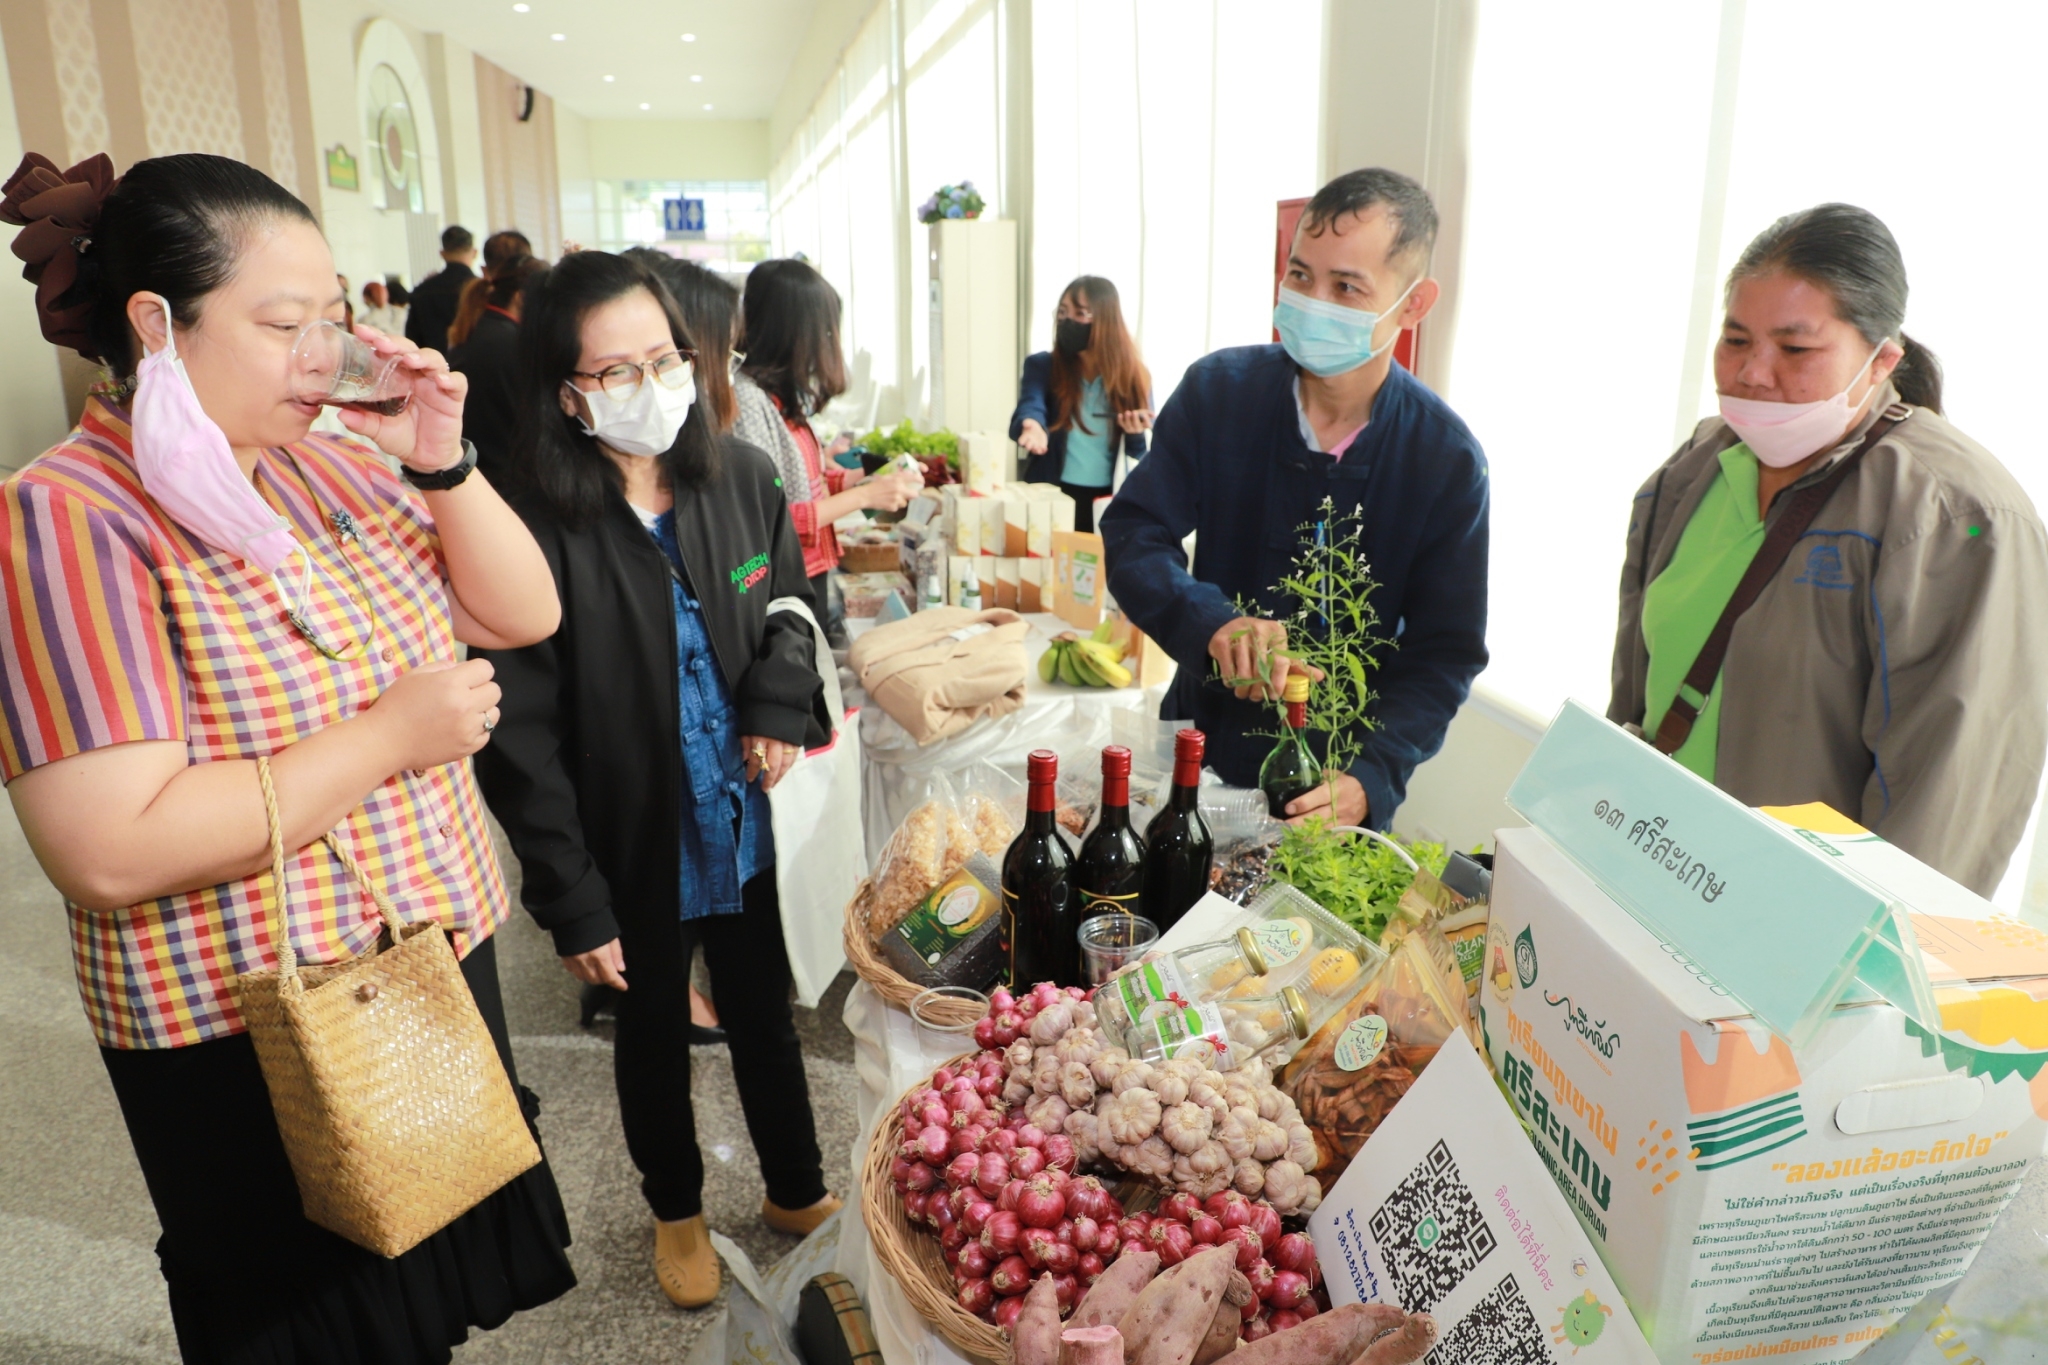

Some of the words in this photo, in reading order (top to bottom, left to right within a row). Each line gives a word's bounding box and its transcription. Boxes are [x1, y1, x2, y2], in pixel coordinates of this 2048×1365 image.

[731, 552, 768, 584] AGTECH
[744, 566, 767, 588] OTOP
[1594, 799, 1625, 831] ๑๓
[1626, 816, 1727, 903] ศรีสะเกษ
[1507, 1006, 1619, 1157] ทุเรียนภูเขาไฟ
[1503, 1050, 1611, 1212] ศรีสะเกษ
[1558, 1168, 1577, 1204] AREA
[1578, 1193, 1607, 1243] DURIAN
[1725, 1188, 1843, 1211] ไม่ใช่คำกล่าวเกินจริง
[1849, 1158, 2027, 1198] แต่เป็นเรื่องจริงที่ทุกคนต้องมาลอง
[1851, 1232, 1865, 1242] 50
[1873, 1228, 1892, 1239] 100
[1893, 1225, 1914, 1235] เมตร
